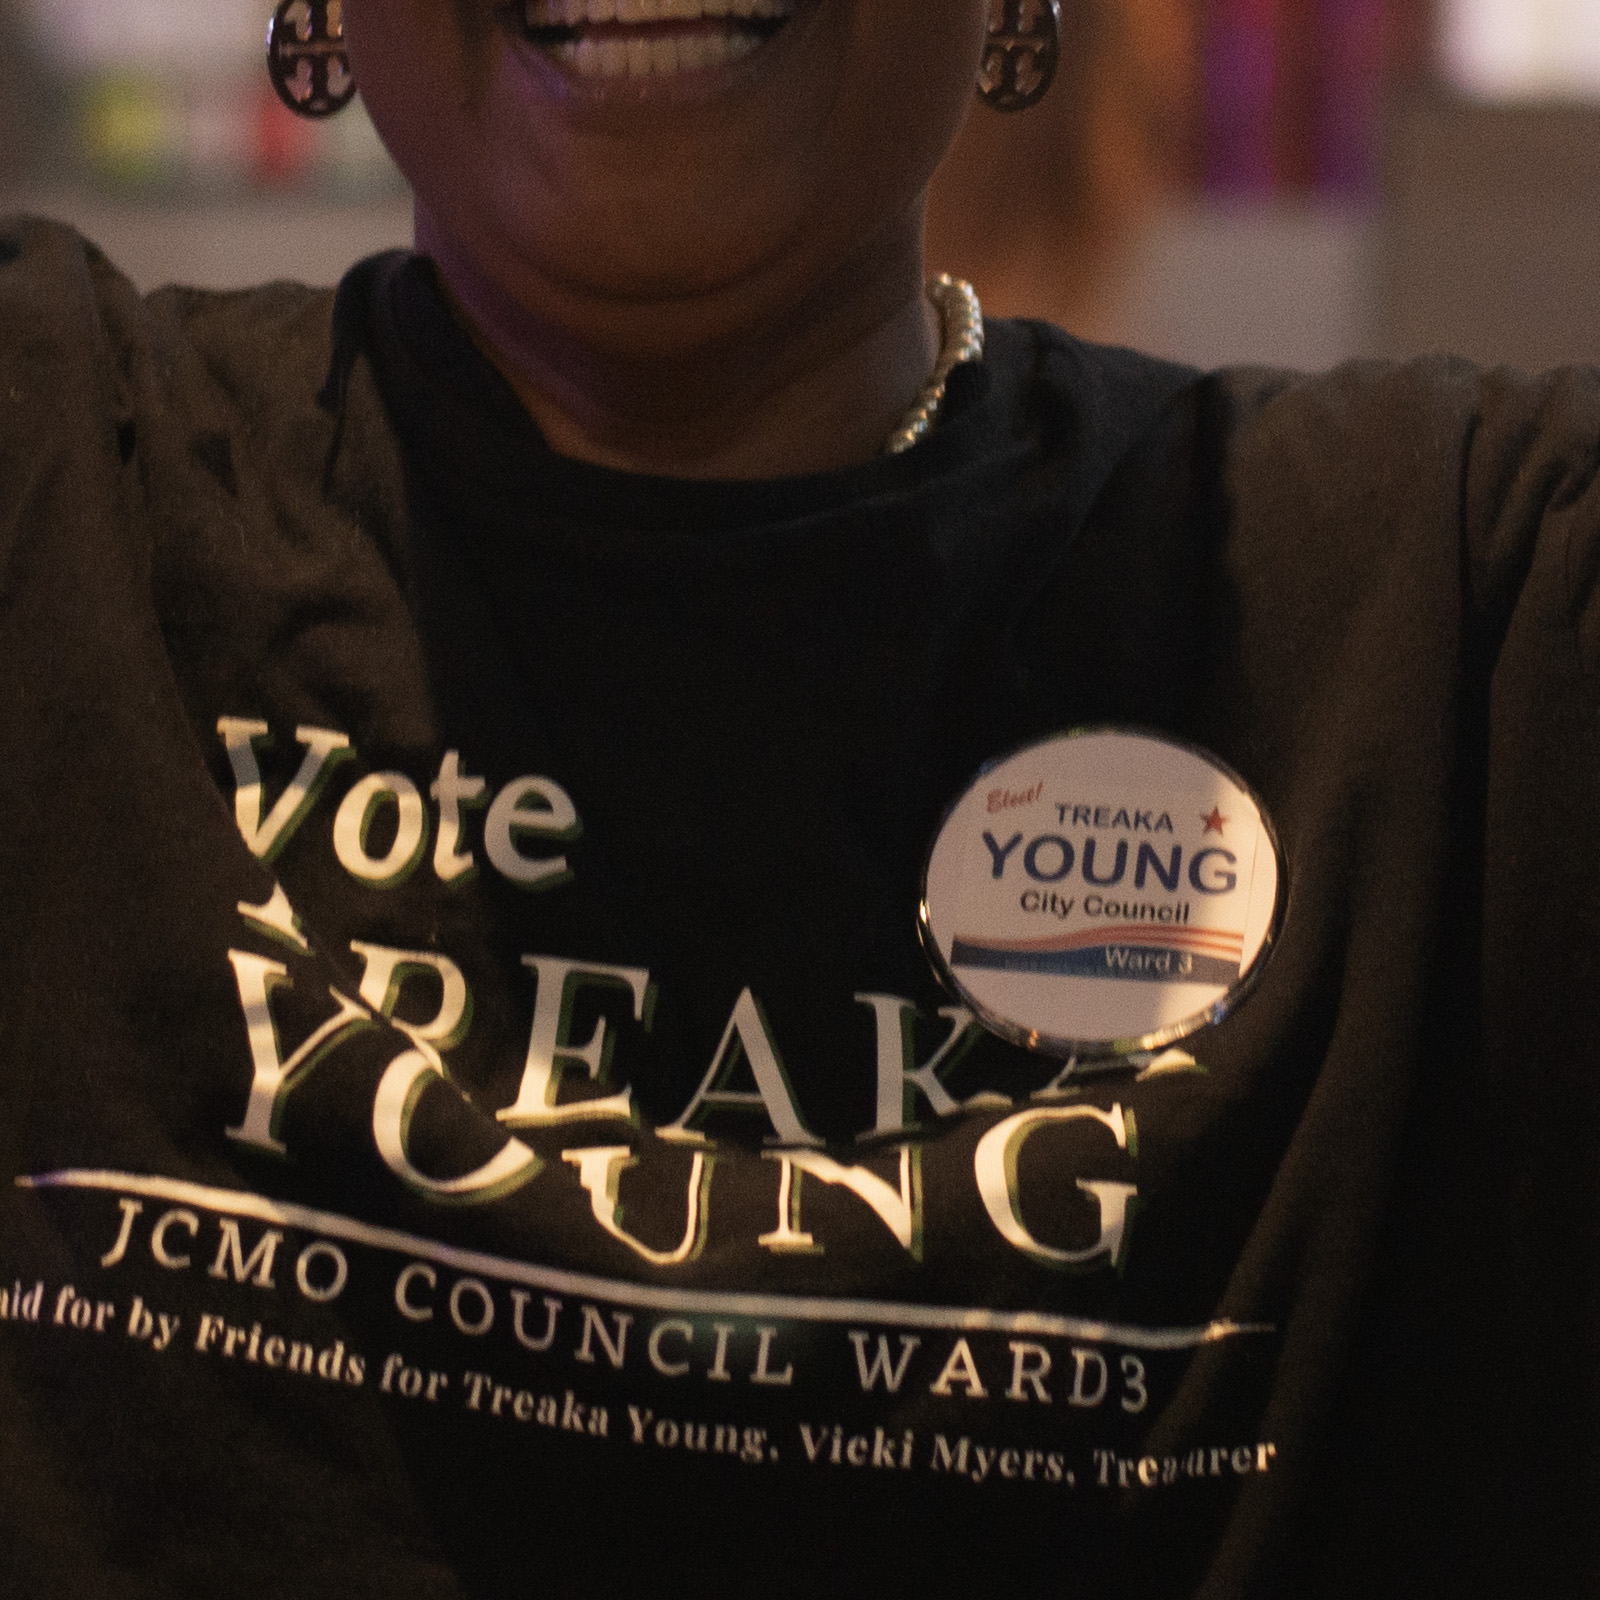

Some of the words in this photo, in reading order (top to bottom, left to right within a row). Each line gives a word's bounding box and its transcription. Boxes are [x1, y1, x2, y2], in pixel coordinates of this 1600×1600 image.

[216, 715, 582, 890] Vote
[982, 829, 1238, 895] YOUNG
[1055, 802, 1174, 834] TREAKA
[1019, 890, 1075, 920] City
[1083, 894, 1190, 926] Council
[1105, 946, 1172, 973] Ward
[236, 881, 1200, 1148] REAK
[225, 948, 1140, 1270] YOUNG
[53, 1285, 115, 1333] for
[127, 1296, 181, 1351] by
[194, 1312, 367, 1388] Friends
[379, 1353, 448, 1402] for
[463, 1371, 610, 1438] Treaka
[800, 1422, 916, 1471] Vicki
[101, 1199, 348, 1302] JCMO
[395, 1263, 794, 1386] COUNCIL
[848, 1330, 1148, 1414] WARD3
